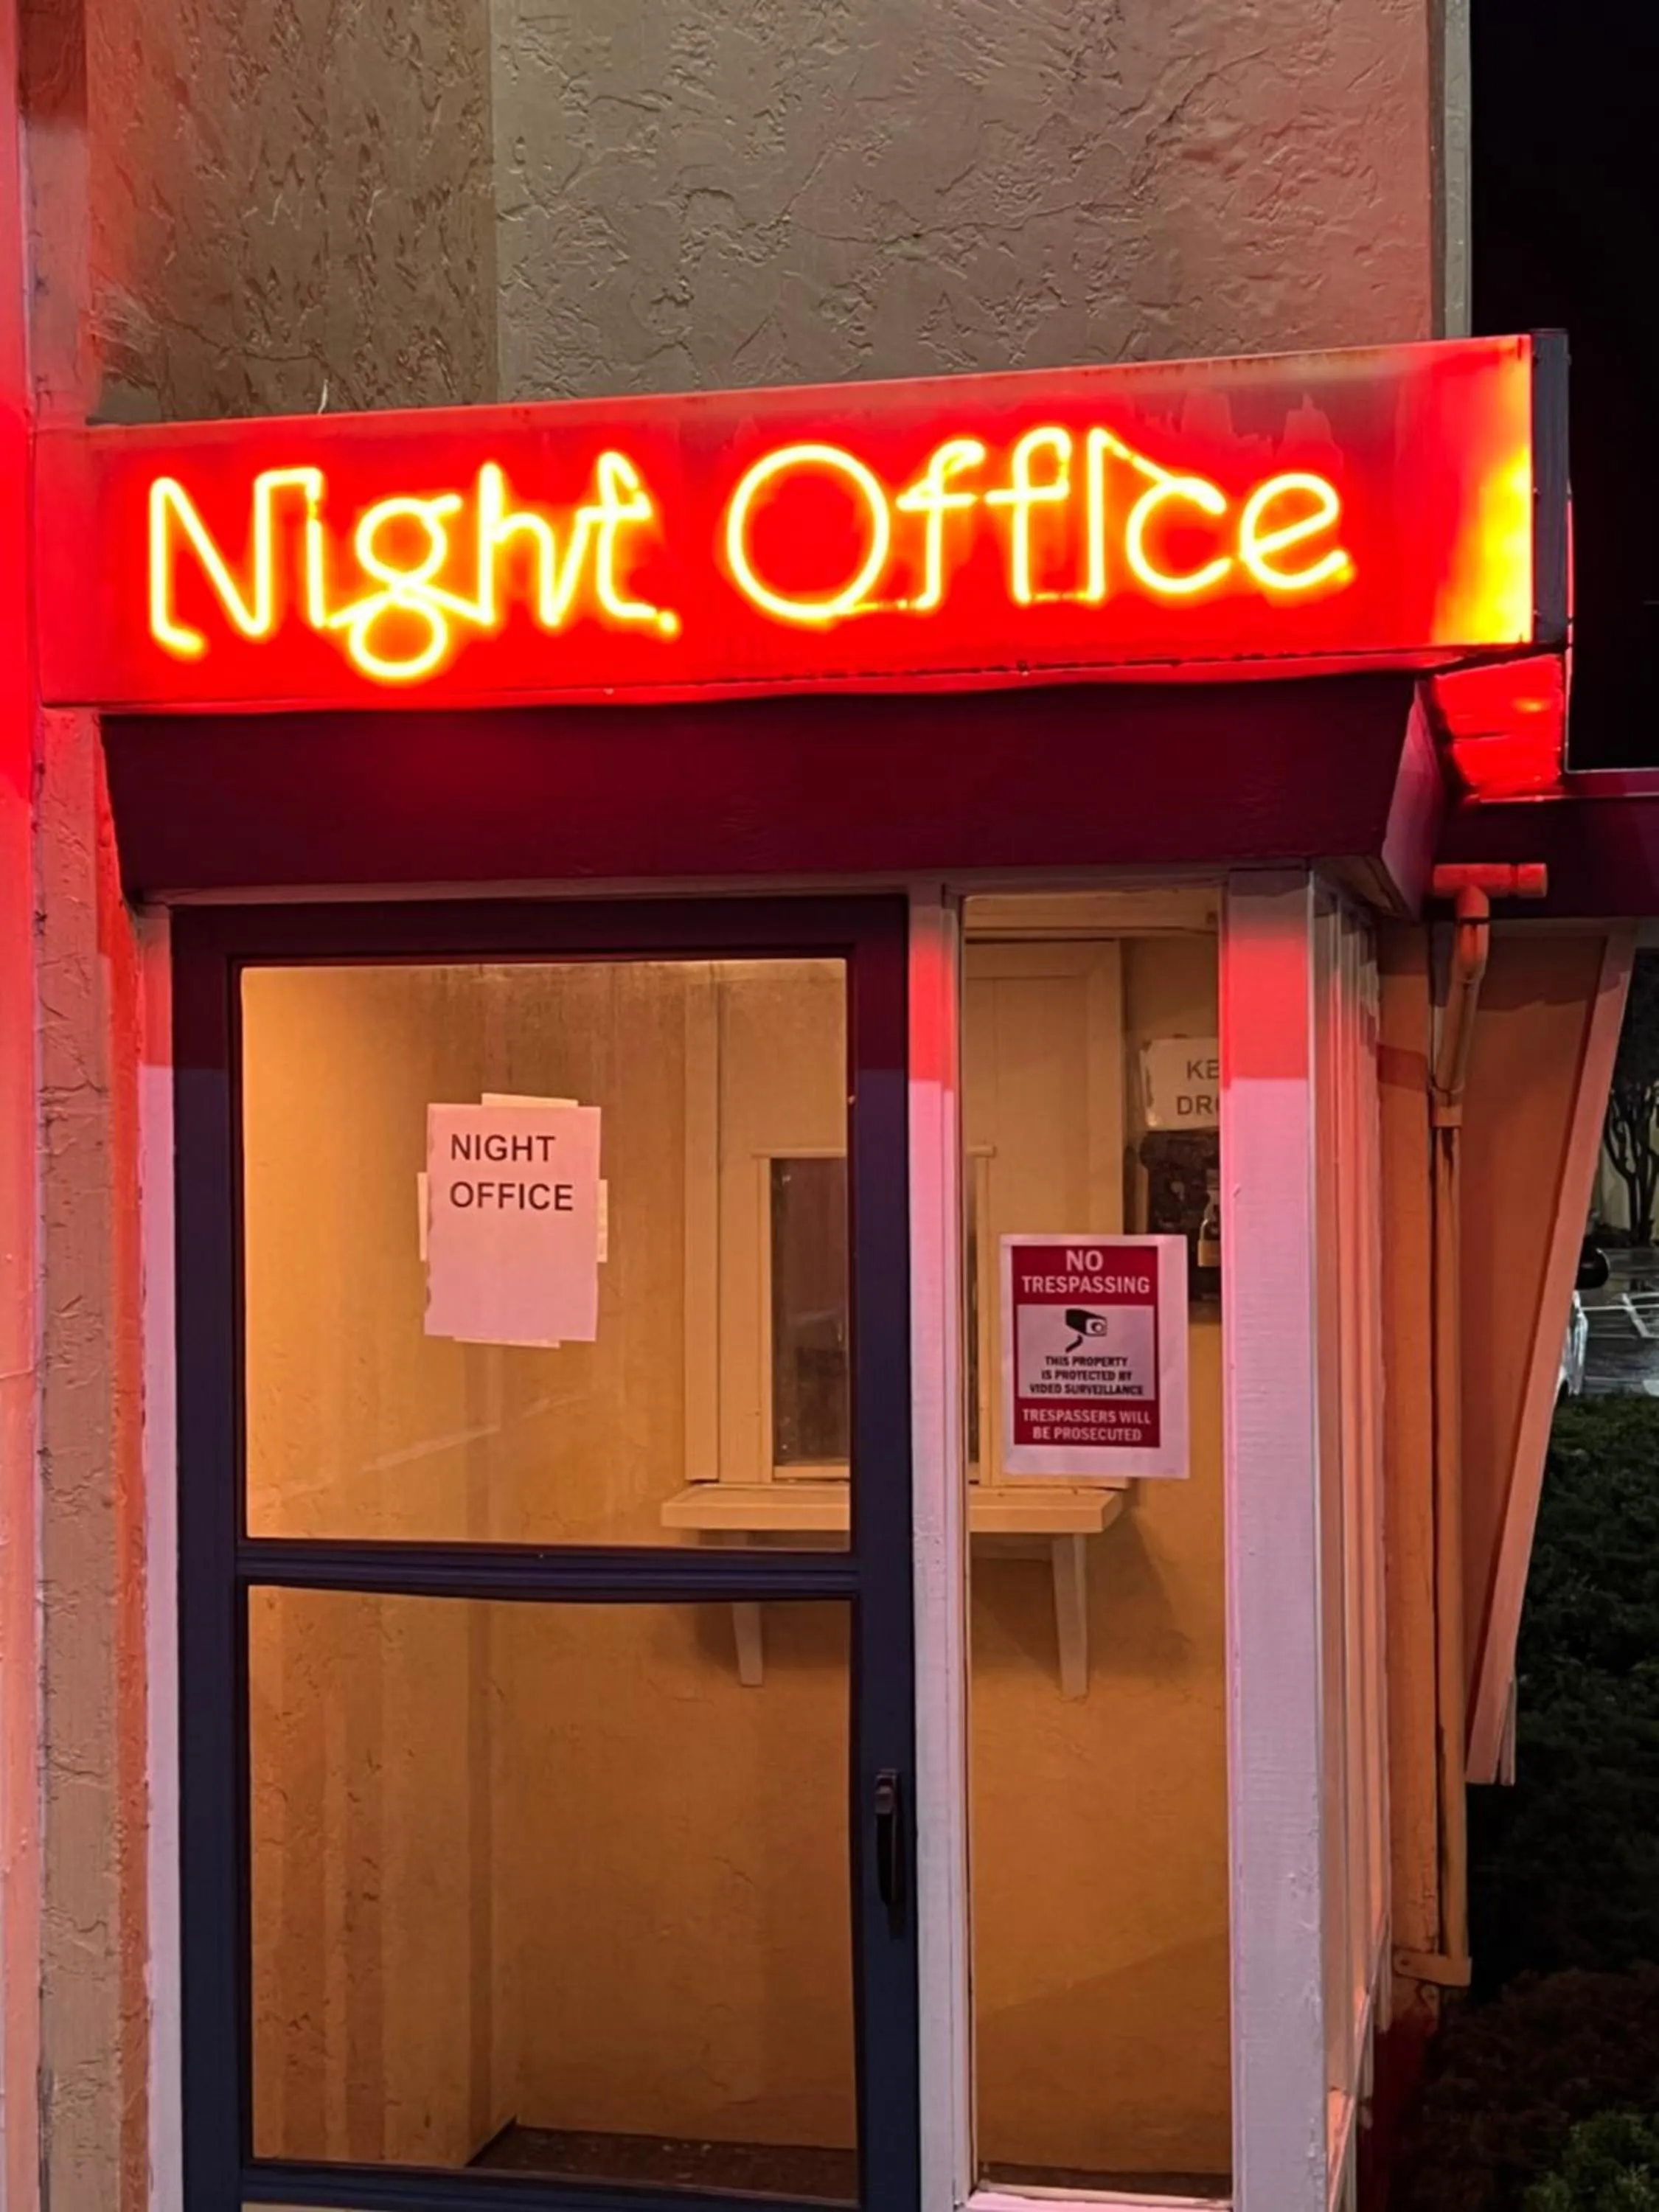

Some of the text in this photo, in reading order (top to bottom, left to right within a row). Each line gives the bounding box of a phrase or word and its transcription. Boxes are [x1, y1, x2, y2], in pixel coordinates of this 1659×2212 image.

[150, 425, 1354, 683] Night Office
[1177, 1095, 1220, 1116] DR
[451, 1133, 556, 1162] NIGHT
[449, 1181, 574, 1211] OFFICE
[1065, 1250, 1105, 1272] NO
[1021, 1275, 1151, 1294] TRESPASSING
[1046, 1355, 1128, 1367] THIS PROPERTY
[1041, 1370, 1133, 1382] IS PROTECTED BY
[1029, 1383, 1144, 1396] VIDEO SURVEILLANCE
[1023, 1408, 1152, 1425] TRESPASSERS WILL
[1032, 1426, 1142, 1441] BE PROSECUTED
